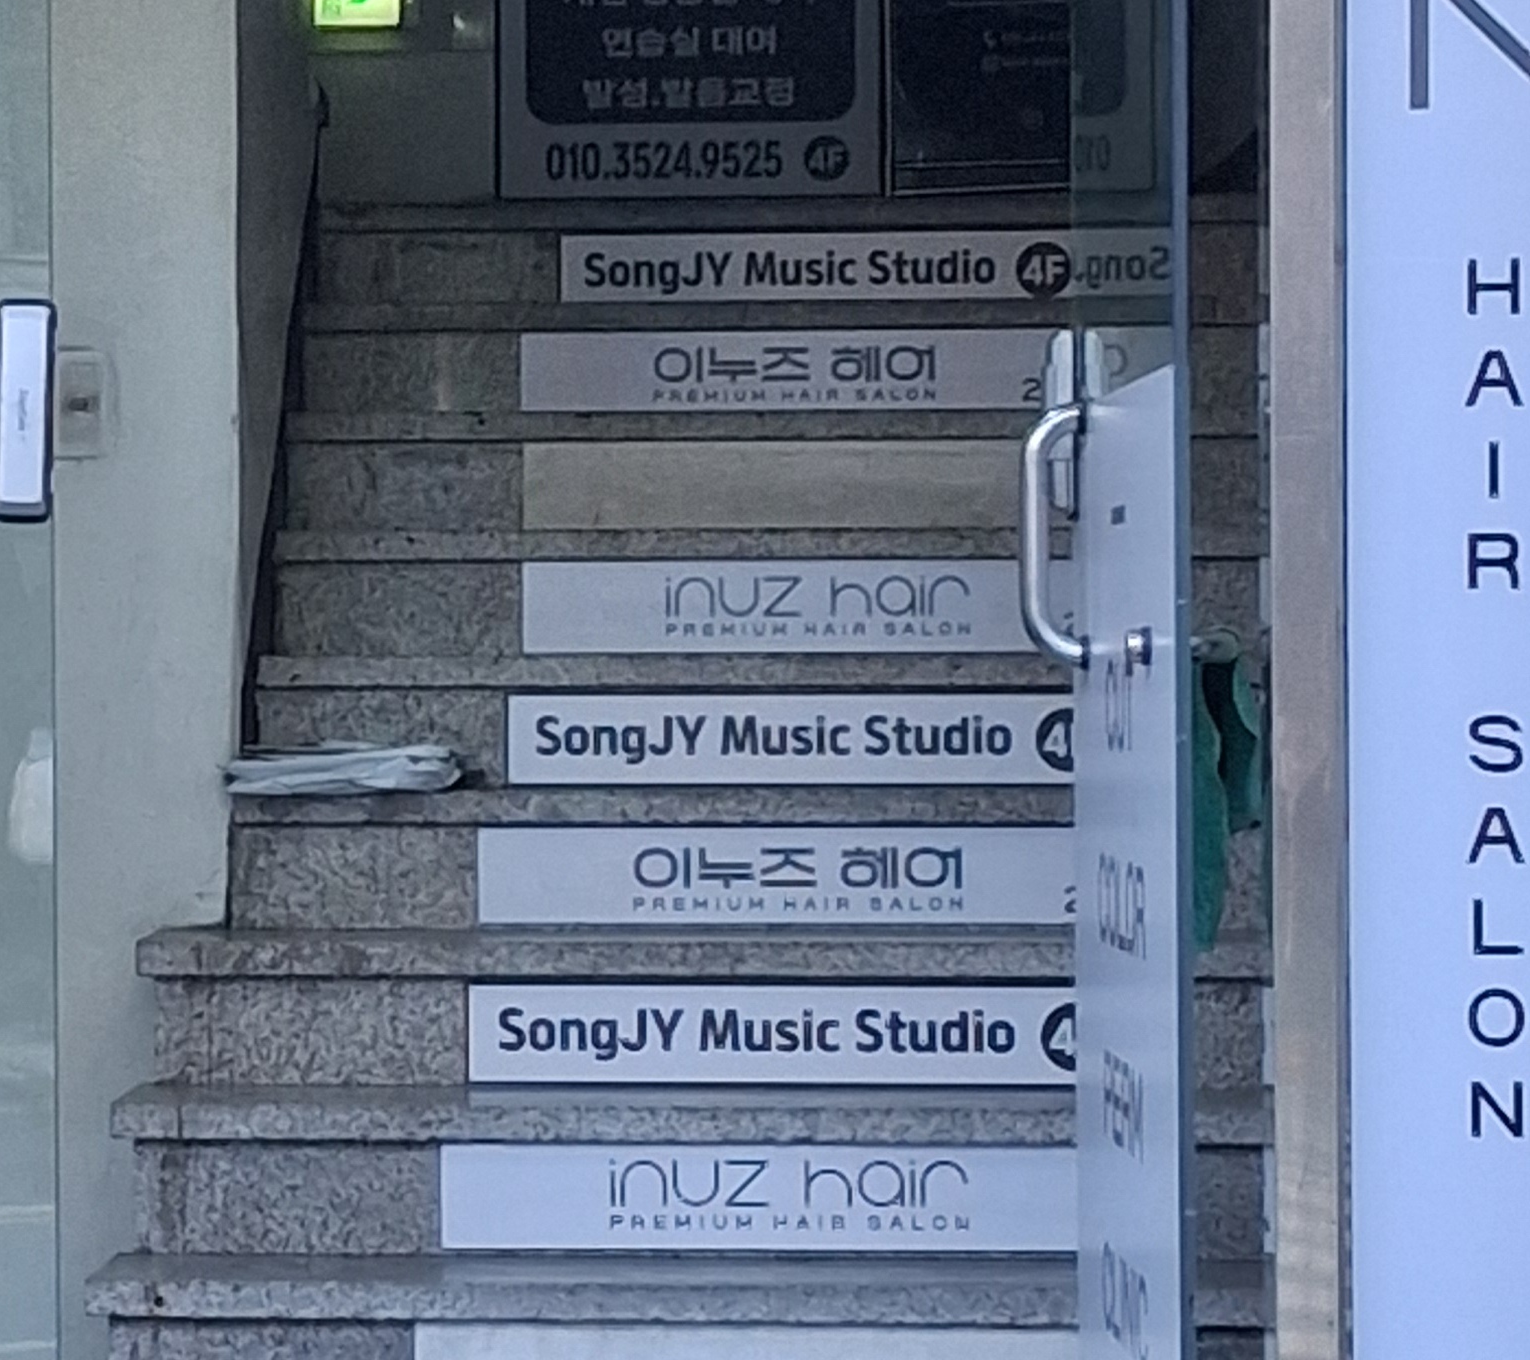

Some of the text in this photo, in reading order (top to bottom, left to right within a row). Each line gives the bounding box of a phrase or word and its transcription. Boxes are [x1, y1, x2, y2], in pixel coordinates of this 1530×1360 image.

[545, 141, 849, 180] 010.3524.9525 4F
[583, 248, 1067, 296] SongJY Music Studio 4F
[653, 344, 937, 384] 이누즈 헤어
[650, 389, 768, 404] PREMIUM
[780, 387, 840, 403] HAIR
[854, 386, 938, 403] SALON
[664, 574, 971, 618] inuz hair
[665, 623, 972, 637] PREMIUM HAIR SALON
[1464, 257, 1526, 1140] HAIR SALON
[536, 715, 707, 765] SongJY
[720, 715, 851, 756] Music
[864, 714, 1013, 756] Studio
[633, 846, 963, 890] 이누즈 헤어
[632, 896, 966, 912] PREMIUM HAIR SALON
[1097, 852, 1146, 960] COLOR
[498, 1007, 684, 1062] SongJY
[699, 1008, 840, 1053] Music
[855, 1008, 1016, 1054] Studio
[1103, 1049, 1145, 1166] PERM
[609, 1159, 969, 1208] inuz hair
[608, 1214, 970, 1231] PREMIUM HAIR SALON
